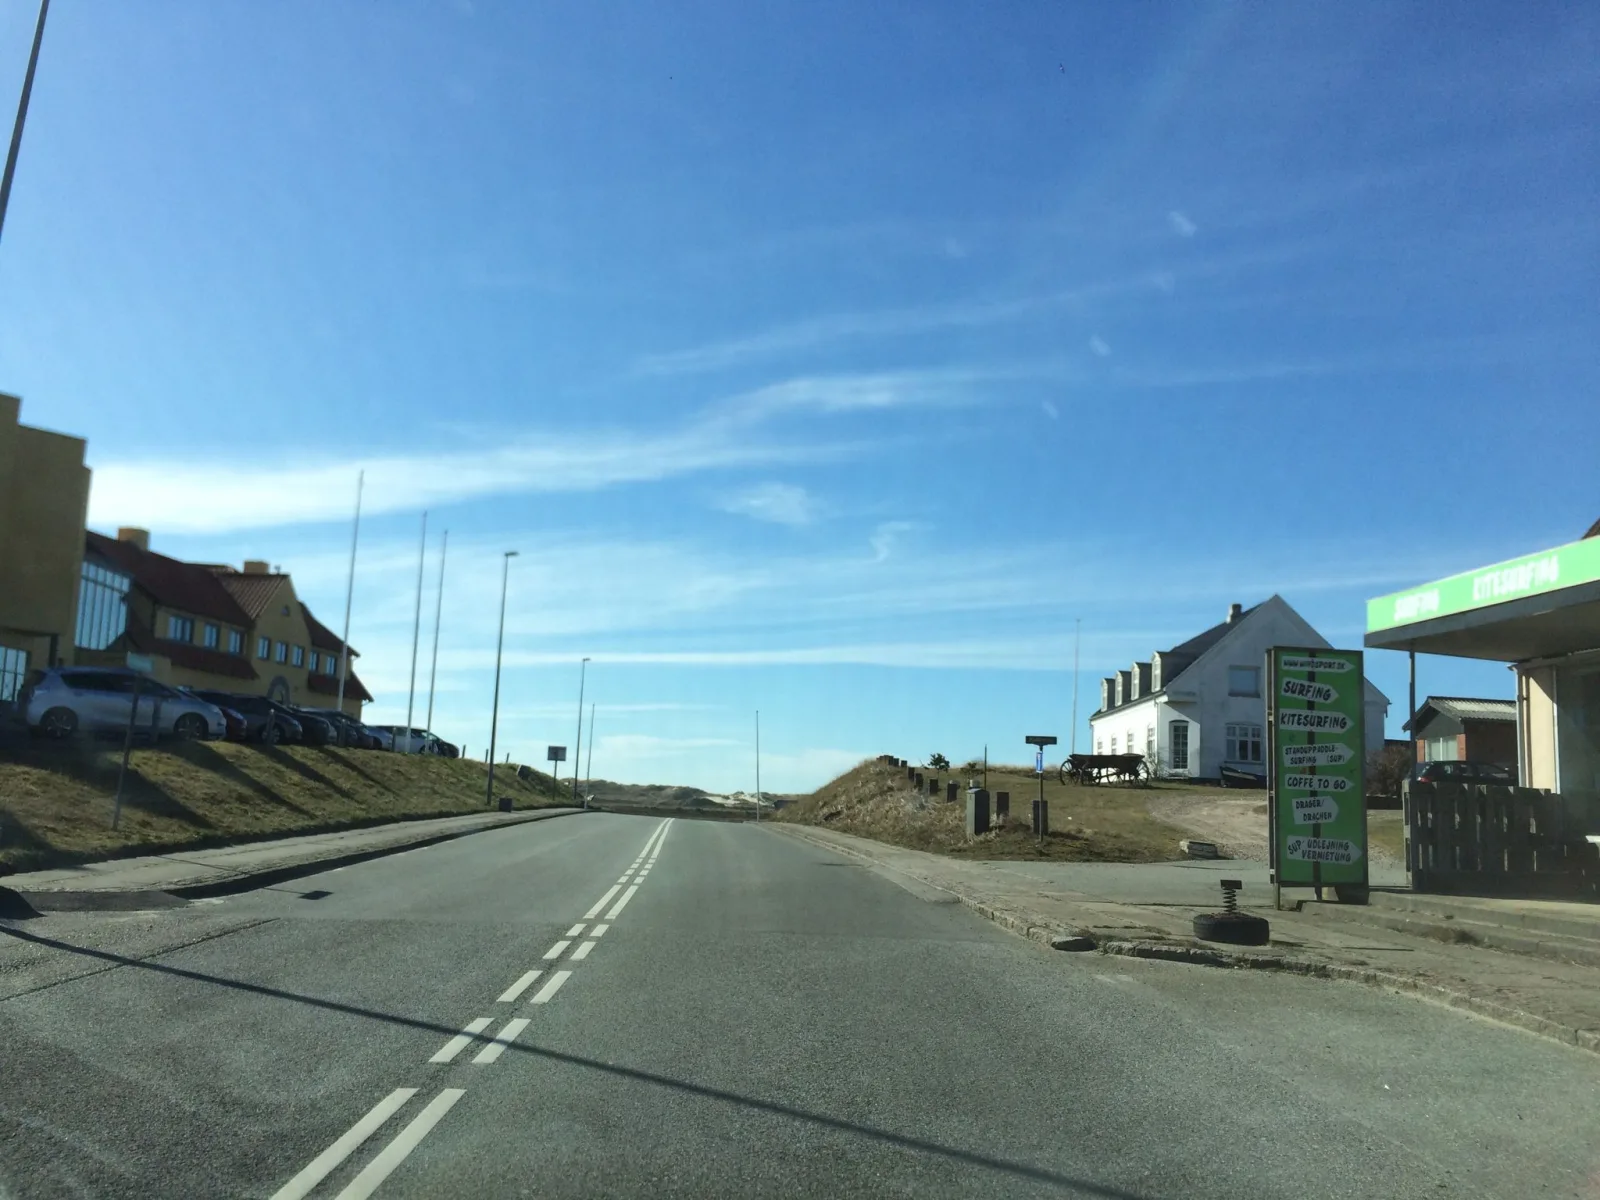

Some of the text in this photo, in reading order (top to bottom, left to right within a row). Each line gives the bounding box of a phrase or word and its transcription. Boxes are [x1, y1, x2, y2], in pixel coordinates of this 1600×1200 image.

[1283, 680, 1331, 701] SURFING
[1280, 712, 1347, 730] KITESURFING
[1290, 756, 1316, 764] SURFING
[1287, 777, 1346, 789] COFFE TO GO
[1303, 811, 1332, 821] DRACHEN
[1307, 839, 1350, 851] UDLEJNING
[1302, 850, 1351, 862] VERMIETUNG
